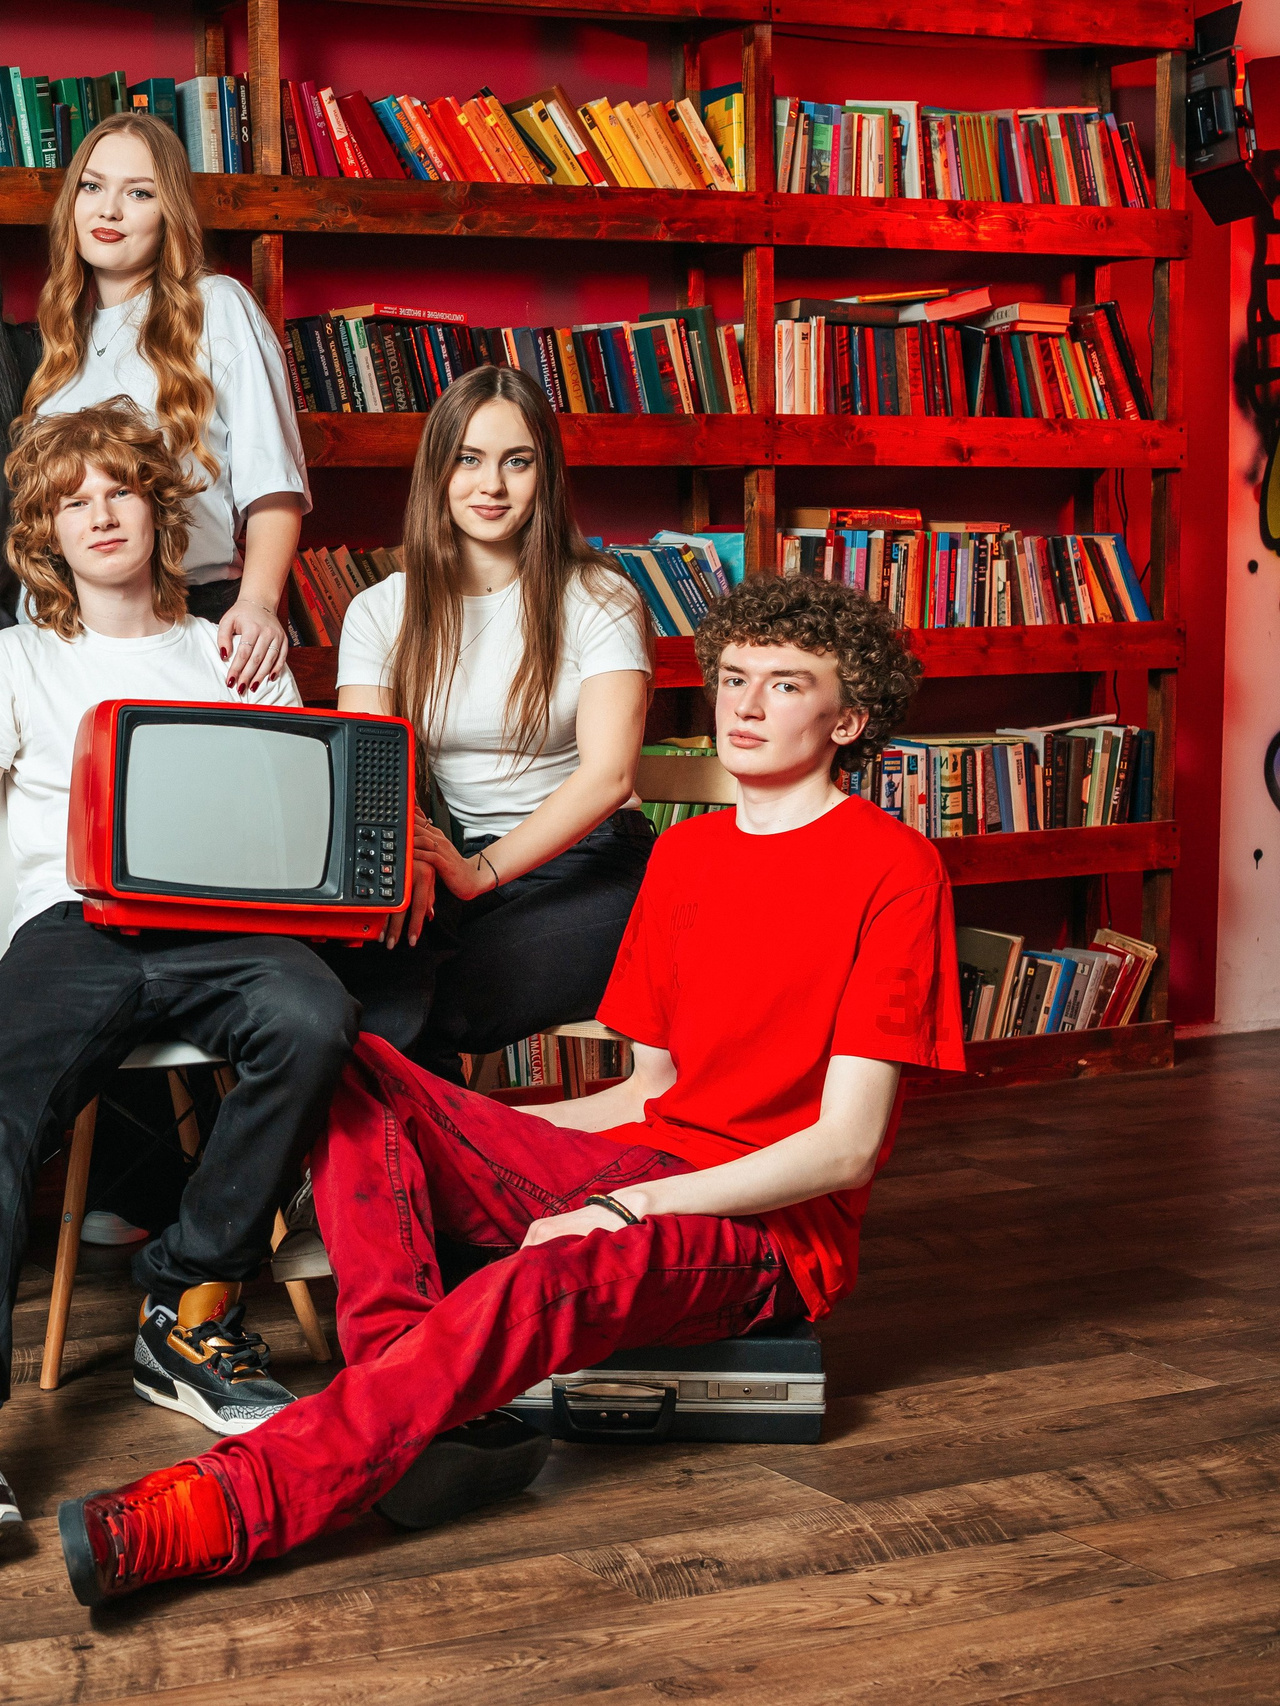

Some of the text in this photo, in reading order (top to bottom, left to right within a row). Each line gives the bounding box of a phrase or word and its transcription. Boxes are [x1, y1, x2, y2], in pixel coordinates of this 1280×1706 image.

[396, 112, 420, 151] ДИАНЕТИКА
[426, 310, 464, 322] САМОГОНОВАРЕНИЕ
[296, 398, 307, 409] ТРИ
[392, 375, 408, 412] КАРЛО
[874, 966, 951, 1042] 31
